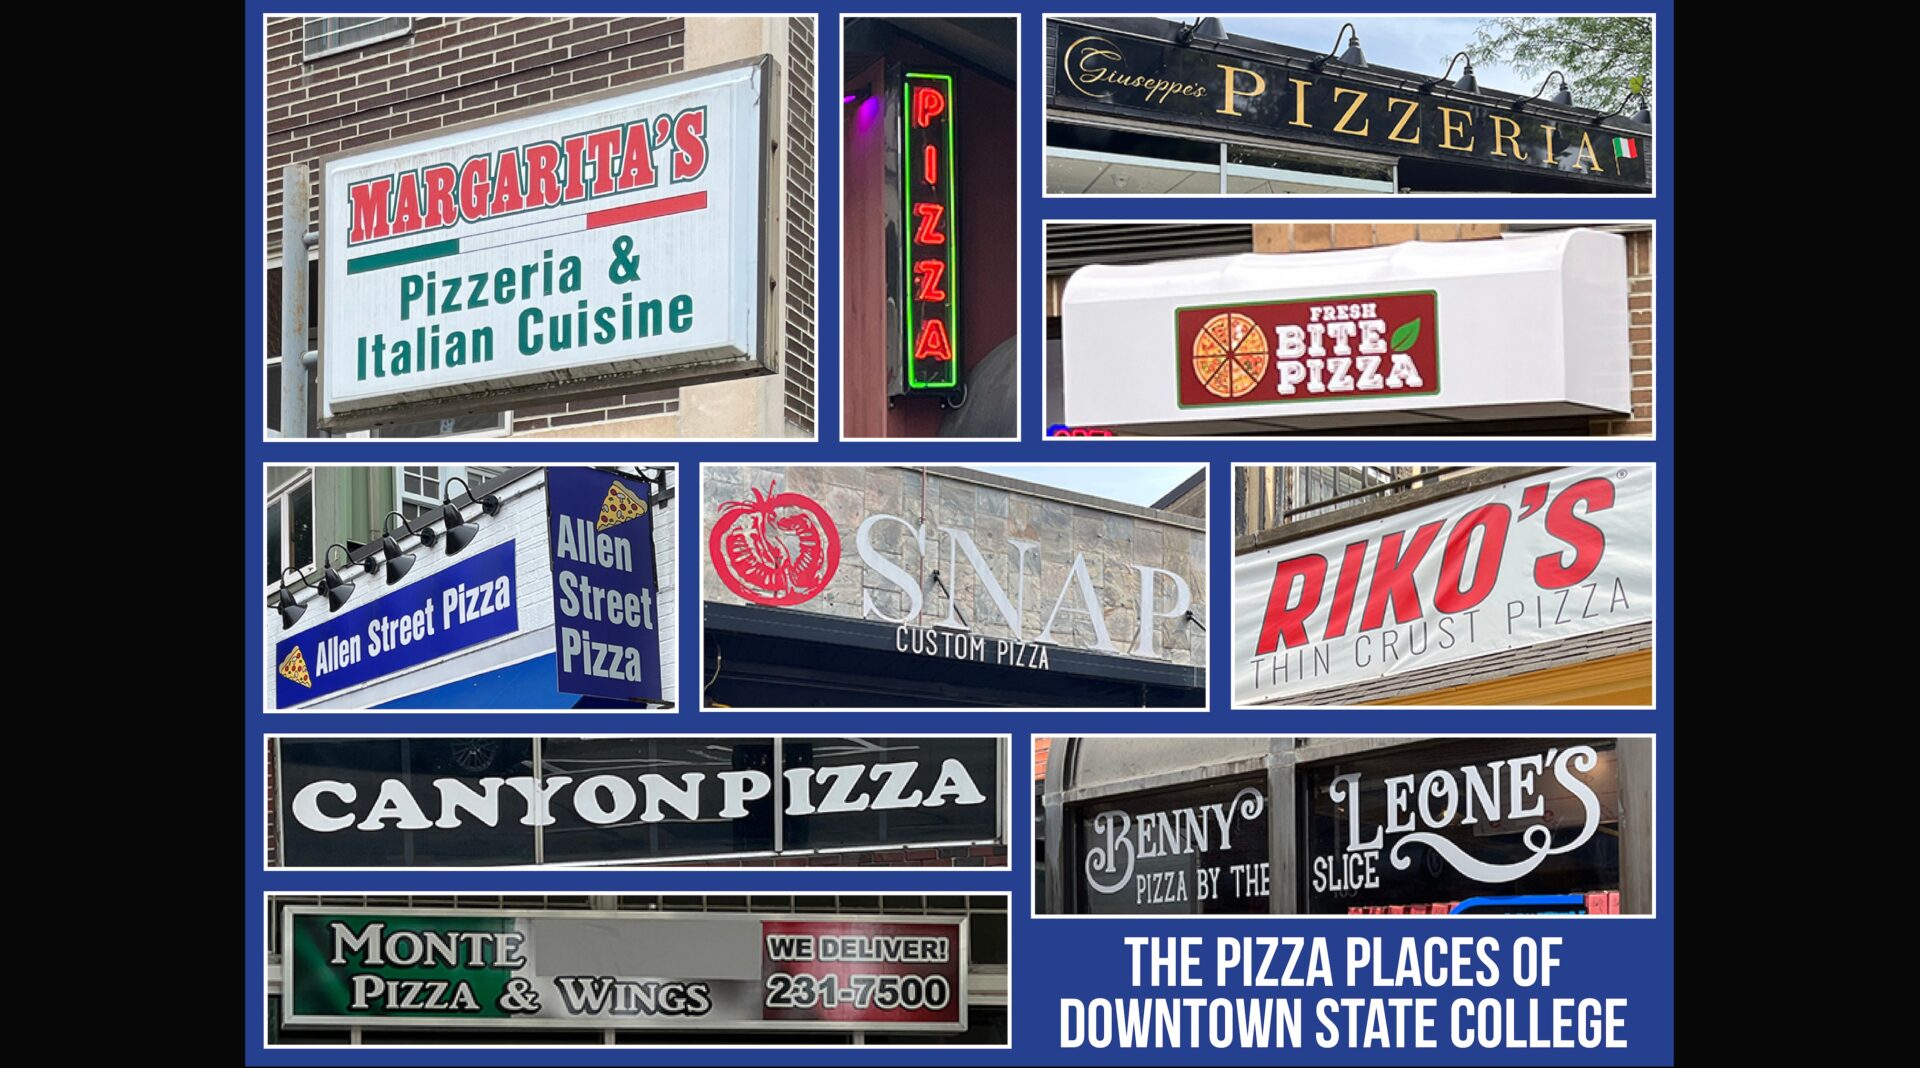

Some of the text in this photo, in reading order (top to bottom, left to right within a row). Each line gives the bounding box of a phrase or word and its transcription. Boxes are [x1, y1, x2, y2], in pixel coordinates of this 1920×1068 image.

[1078, 47, 1604, 172] Giuseppe's PIZZERIA
[347, 104, 708, 247] MARGARITA'S
[913, 86, 953, 361] PIZZA
[401, 234, 641, 320] Pizzeria &
[357, 293, 694, 380] Italian Cuisine
[1275, 319, 1387, 358] BITE
[1310, 302, 1377, 323] FRESH
[1277, 354, 1423, 395] PIZZA
[557, 514, 633, 573] Allen
[1255, 477, 1616, 656] RIKO'S
[558, 570, 653, 630] Street
[856, 513, 1193, 660] SNAP
[315, 575, 510, 677] Allen Street Pizza
[561, 627, 642, 683] Pizza
[895, 625, 1050, 670] CUSTOM PIZZA
[1250, 576, 1630, 689] THIN CRUST PIZZA
[292, 758, 986, 833] CANYON PIZZA
[1085, 745, 1601, 893] BENNY LEONE'S
[1136, 850, 1380, 905] PIZZA BY THE SLICE
[330, 921, 527, 967] MONTE
[767, 934, 949, 962] WE DELIVER!
[351, 975, 712, 1016] PIZZA & WINGS
[765, 973, 950, 1010] 231-7500
